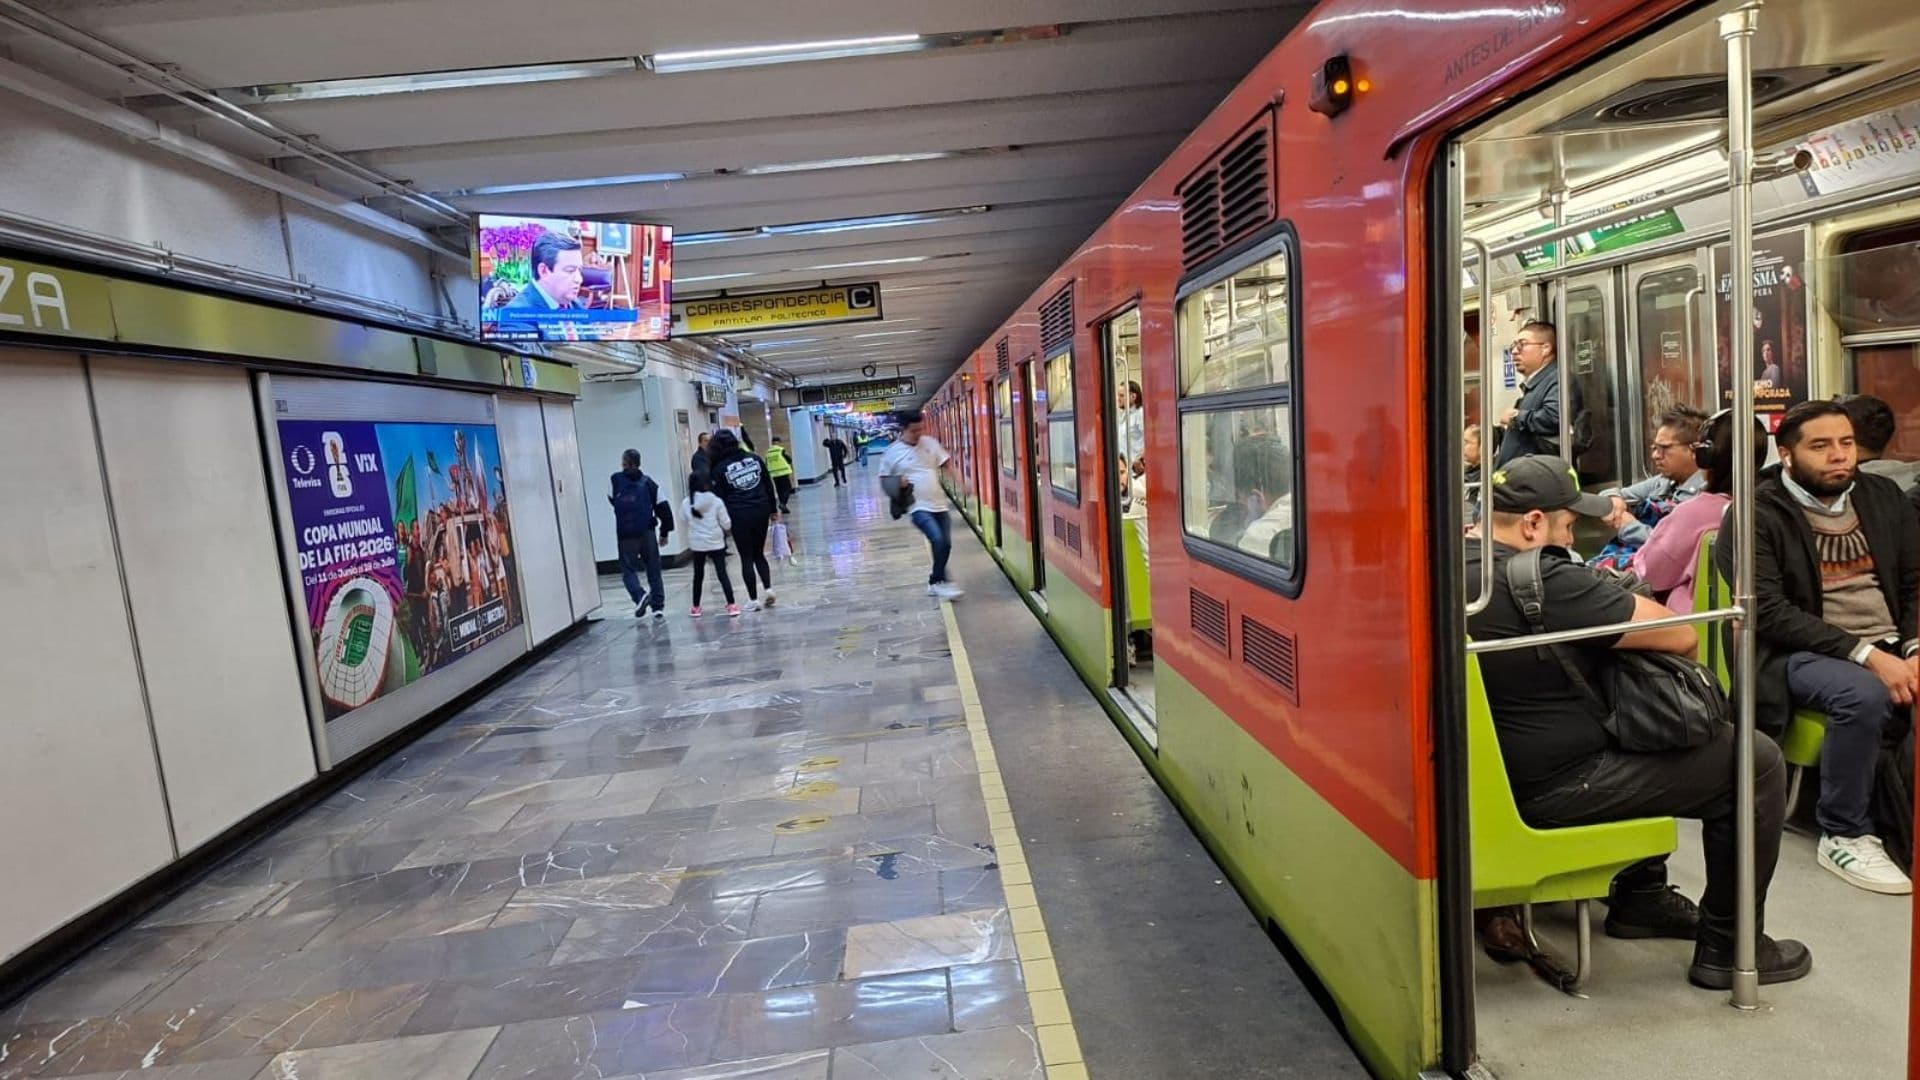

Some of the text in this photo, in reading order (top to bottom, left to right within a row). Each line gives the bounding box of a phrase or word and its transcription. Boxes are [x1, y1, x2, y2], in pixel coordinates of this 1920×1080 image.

[1445, 26, 1511, 84] ANTES DE
[0, 265, 71, 331] ZA
[686, 291, 846, 318] CORRESPONDENCIA
[851, 287, 871, 308] C
[1753, 287, 1773, 298] PERA
[713, 308, 827, 327] PANTITLAN POLITECNICO
[830, 387, 898, 399] UNIVERSIDAD
[292, 477, 322, 489] Televisa
[304, 516, 384, 546] COPA MUNDIAL
[299, 535, 392, 570] DE LA FIFA 2026
[305, 574, 318, 586] Del
[318, 572, 328, 583] 11
[328, 570, 337, 580] de
[337, 564, 358, 578] Junio
[380, 556, 396, 568] Julio
